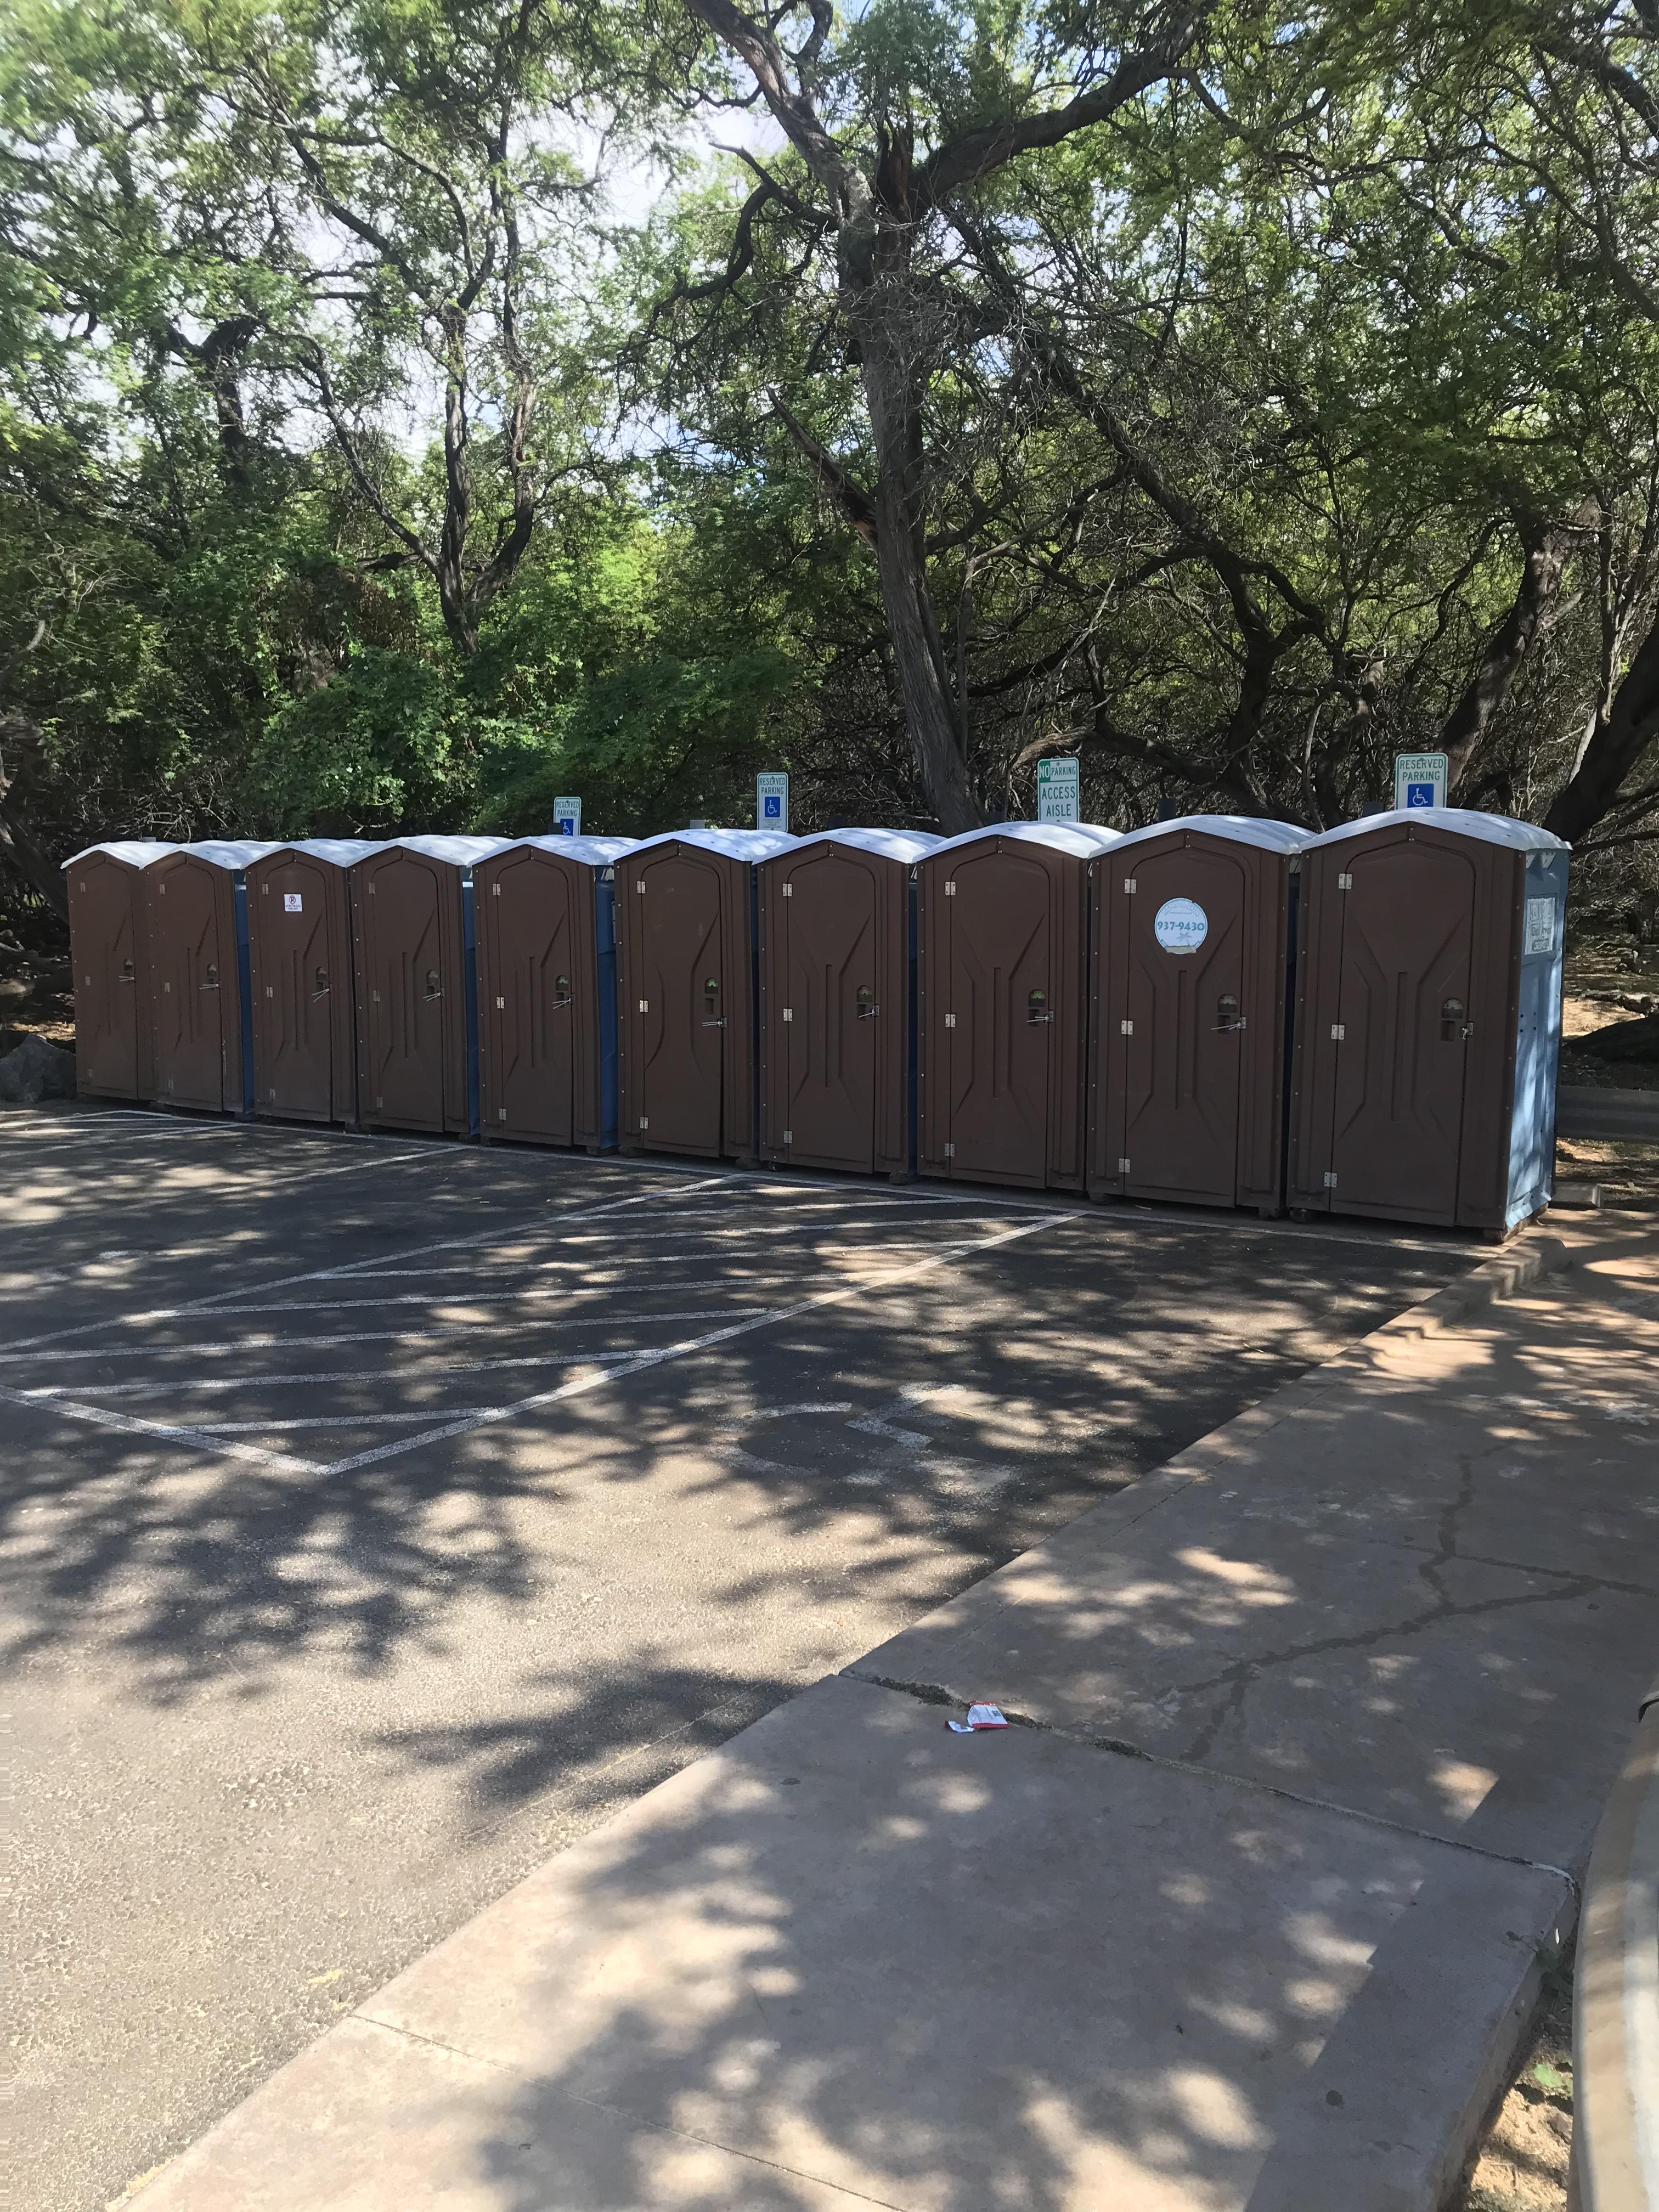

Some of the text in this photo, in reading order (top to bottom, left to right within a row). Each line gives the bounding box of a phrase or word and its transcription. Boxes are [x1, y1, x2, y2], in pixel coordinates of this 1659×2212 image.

[1400, 759, 1443, 769] RESERVED
[1039, 765, 1076, 778] NO PARKING
[1402, 771, 1440, 781] PARKING
[759, 777, 786, 786] RESERVED
[761, 787, 784, 795] PARKING
[1041, 786, 1075, 800] ACCESS
[1046, 804, 1071, 817] AISLE
[1157, 921, 1205, 931] 937-9430
